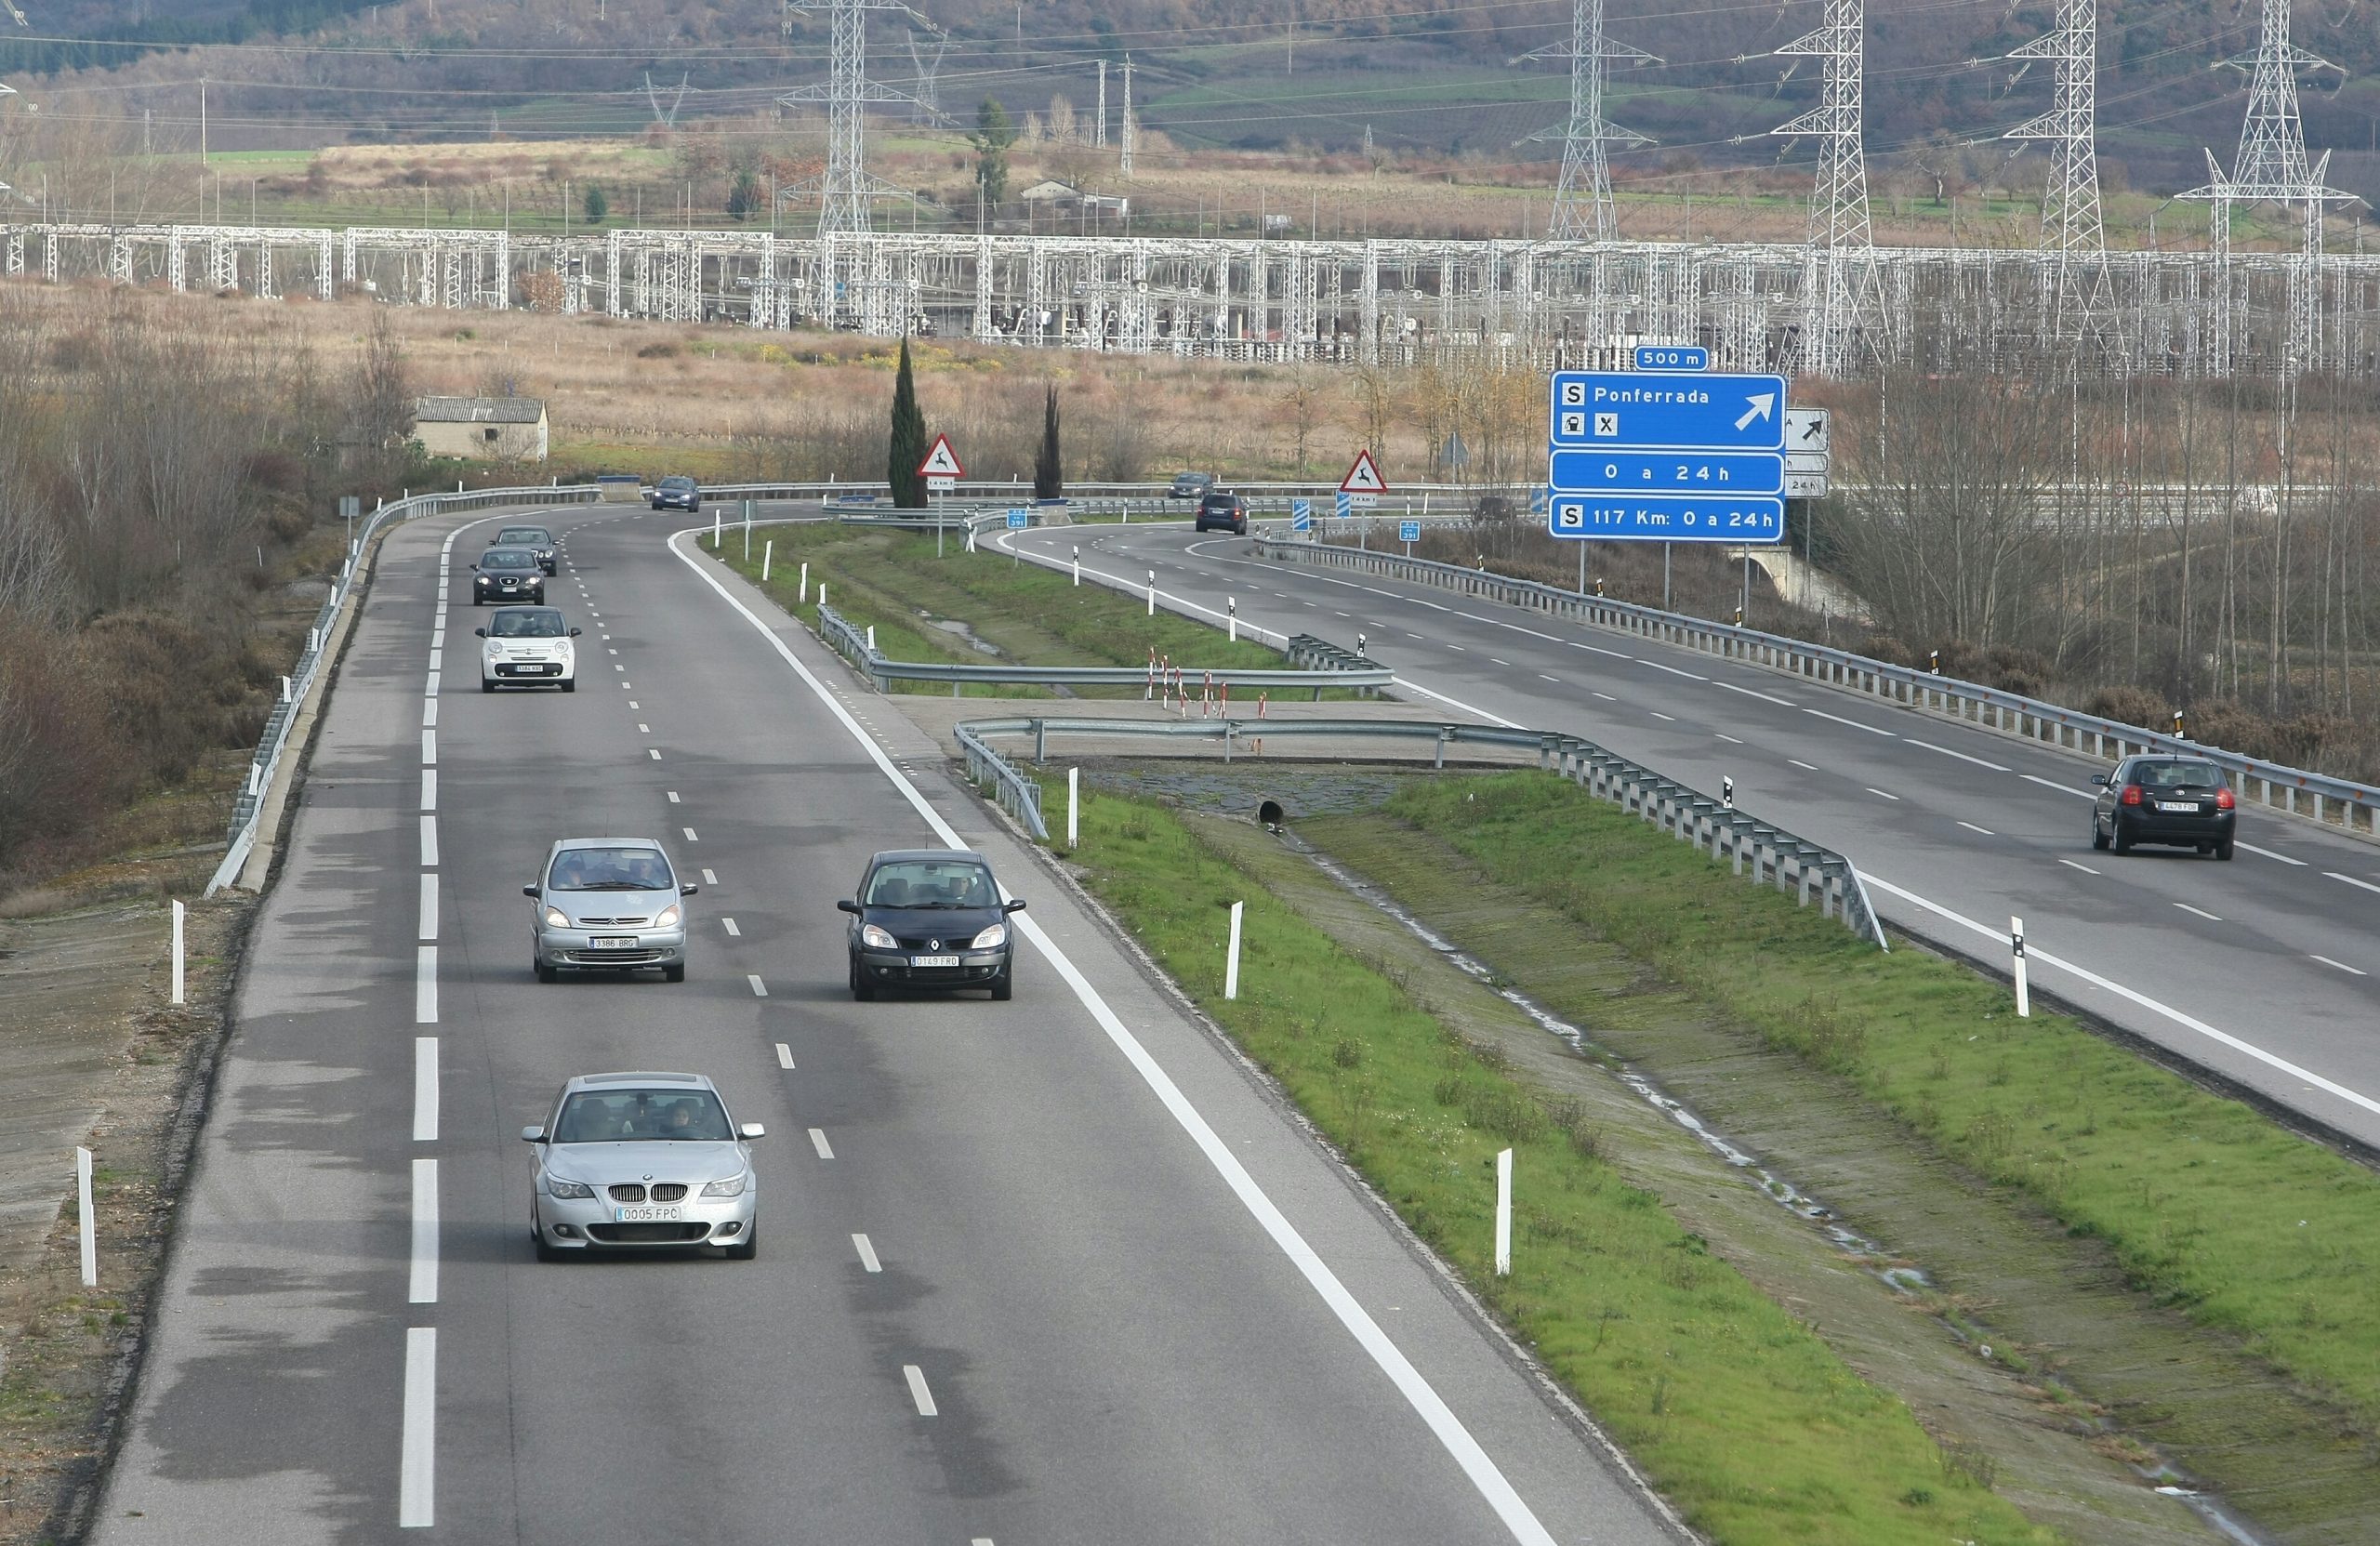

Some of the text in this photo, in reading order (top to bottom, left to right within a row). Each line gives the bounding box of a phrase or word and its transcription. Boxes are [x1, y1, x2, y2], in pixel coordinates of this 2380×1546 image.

[1644, 352, 1699, 365] 500 m
[1567, 385, 1709, 403] S Ponferrada
[1642, 469, 1652, 480] a
[1565, 508, 1579, 524] S
[1593, 509, 1625, 524] 117
[1636, 510, 1670, 525] Km:
[1684, 511, 1696, 525] 0
[1708, 515, 1718, 526] a
[2165, 802, 2183, 811] 4478
[624, 1208, 678, 1220] 0005 FPC
